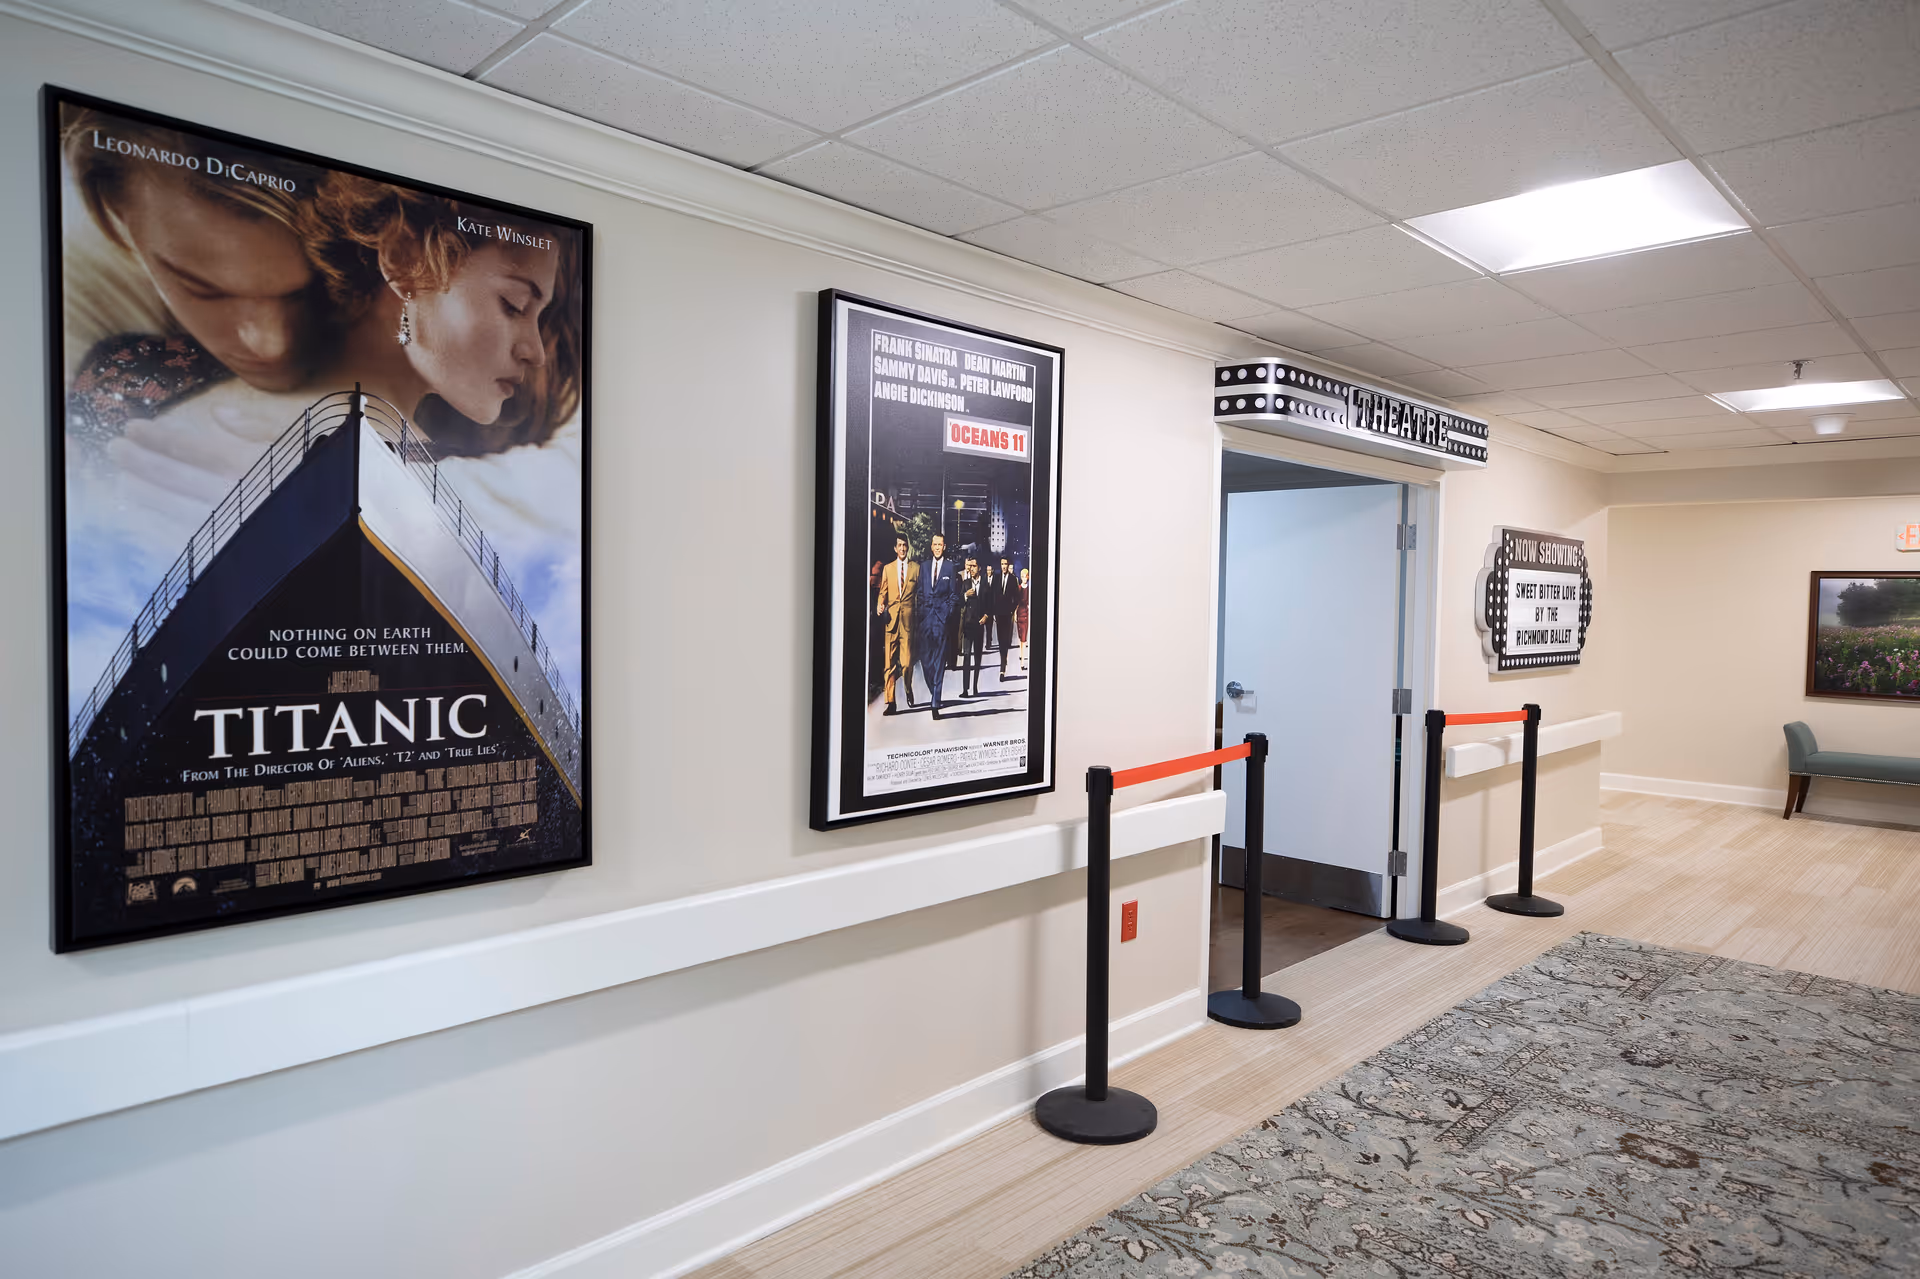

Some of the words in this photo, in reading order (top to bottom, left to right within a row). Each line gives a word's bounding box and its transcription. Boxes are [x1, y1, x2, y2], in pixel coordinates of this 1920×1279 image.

[457, 216, 492, 238] KATE
[496, 225, 552, 250] WINSLET
[874, 333, 912, 358] FRANK
[915, 341, 958, 368] SINATRA
[964, 353, 990, 375] DEAN
[991, 358, 1027, 382] MARTIN
[874, 355, 916, 381] SAMMY
[917, 365, 948, 388] DAVIS
[960, 373, 989, 395] PETER
[990, 379, 1033, 404] LAWFORD
[874, 380, 908, 402] ANGIE
[910, 386, 965, 412] DICKINSON
[1354, 389, 1448, 448] THEATRE
[1514, 538, 1537, 562] NOW
[1539, 541, 1578, 567] SHOWING
[1516, 582, 1537, 599] SWEET
[1540, 583, 1560, 600] BITTER
[1562, 585, 1576, 600] LOVE
[1535, 607, 1544, 622] BY
[1547, 607, 1558, 621] THE
[269, 628, 347, 642] NOTHING
[353, 628, 377, 640] ON
[383, 626, 431, 639] EARTH
[1516, 630, 1549, 646] RICHMOND
[1550, 629, 1571, 644] BALLET
[228, 647, 288, 661] COULD
[295, 645, 343, 659] COME
[349, 643, 420, 657] BETWEEN
[425, 642, 469, 654] THEM.
[193, 694, 488, 759] TITANIC
[934, 745, 968, 754] PANAVISION
[982, 740, 1009, 748] WARNER
